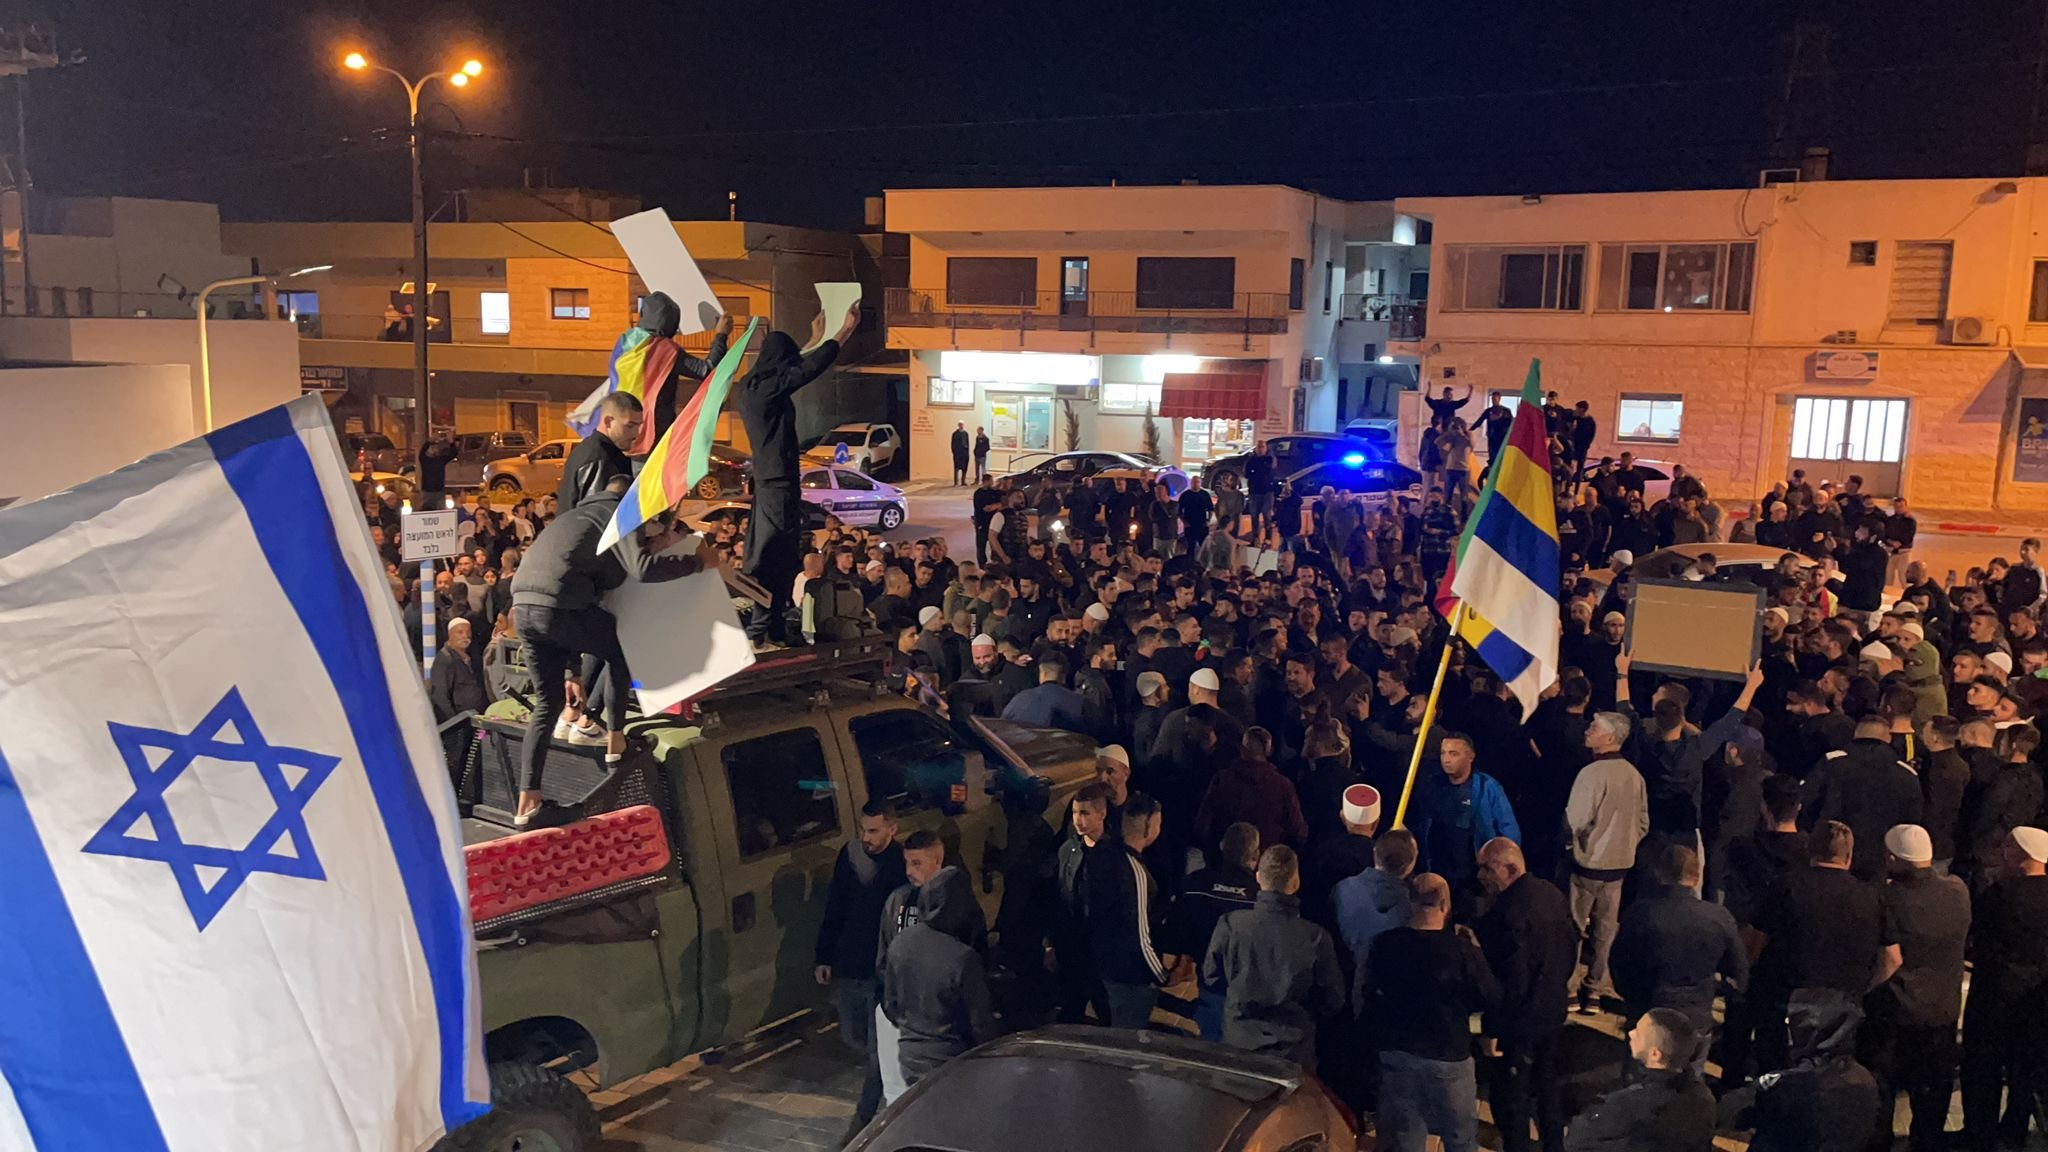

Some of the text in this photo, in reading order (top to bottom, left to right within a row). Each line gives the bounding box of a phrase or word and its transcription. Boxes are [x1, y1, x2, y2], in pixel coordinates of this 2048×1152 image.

[422, 517, 439, 526] שמור
[406, 528, 453, 541] לראש המועצה
[423, 543, 439, 553] בלבד
